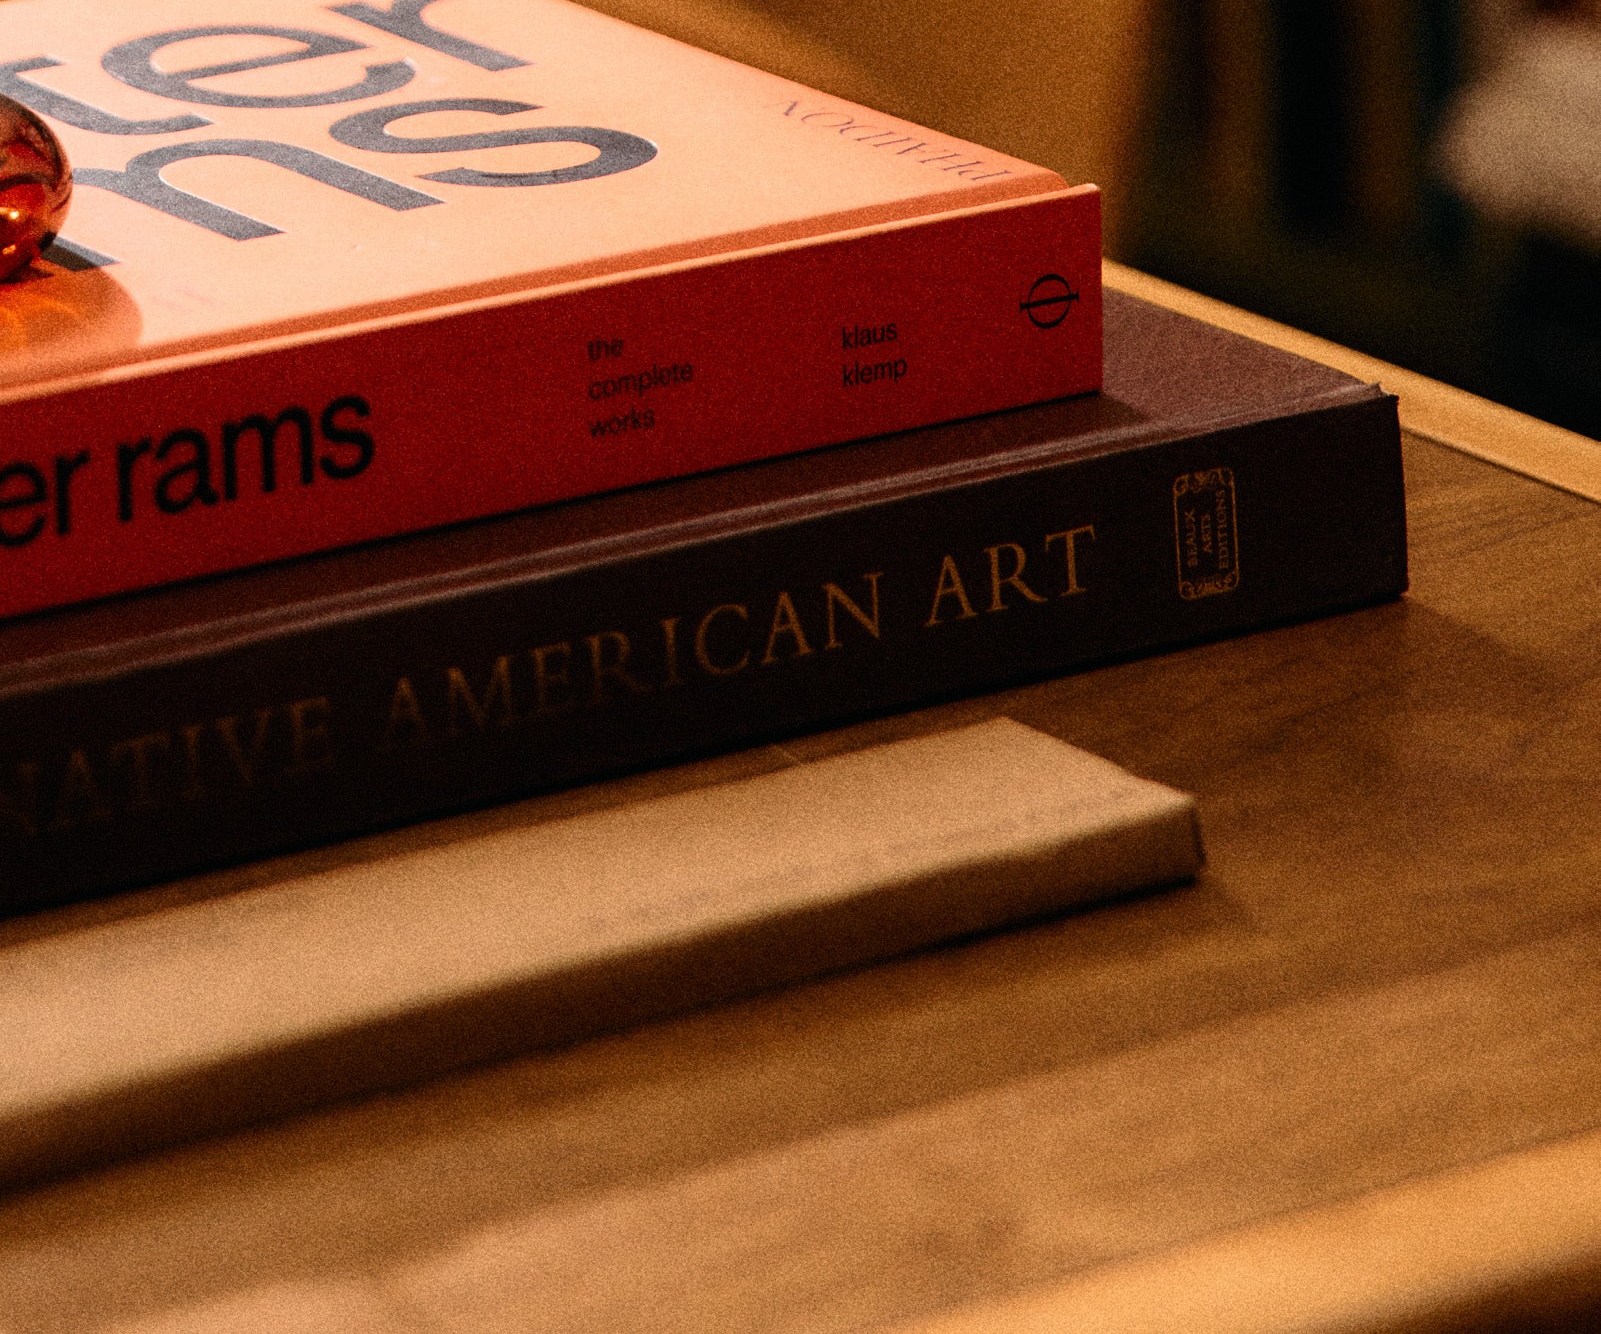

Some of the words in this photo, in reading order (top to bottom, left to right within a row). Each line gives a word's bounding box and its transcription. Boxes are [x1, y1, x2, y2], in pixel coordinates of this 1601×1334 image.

[587, 338, 625, 362] the
[841, 322, 898, 350] klaus
[587, 362, 695, 401] complete
[841, 357, 908, 388] klemp
[588, 407, 656, 438] works
[116, 394, 376, 523] rams
[1183, 507, 1199, 568] BEAUX
[1199, 512, 1213, 554] ARTS
[1214, 489, 1230, 571] EDITIONS
[379, 570, 886, 750] AMERICAN
[923, 523, 1098, 627] ART
